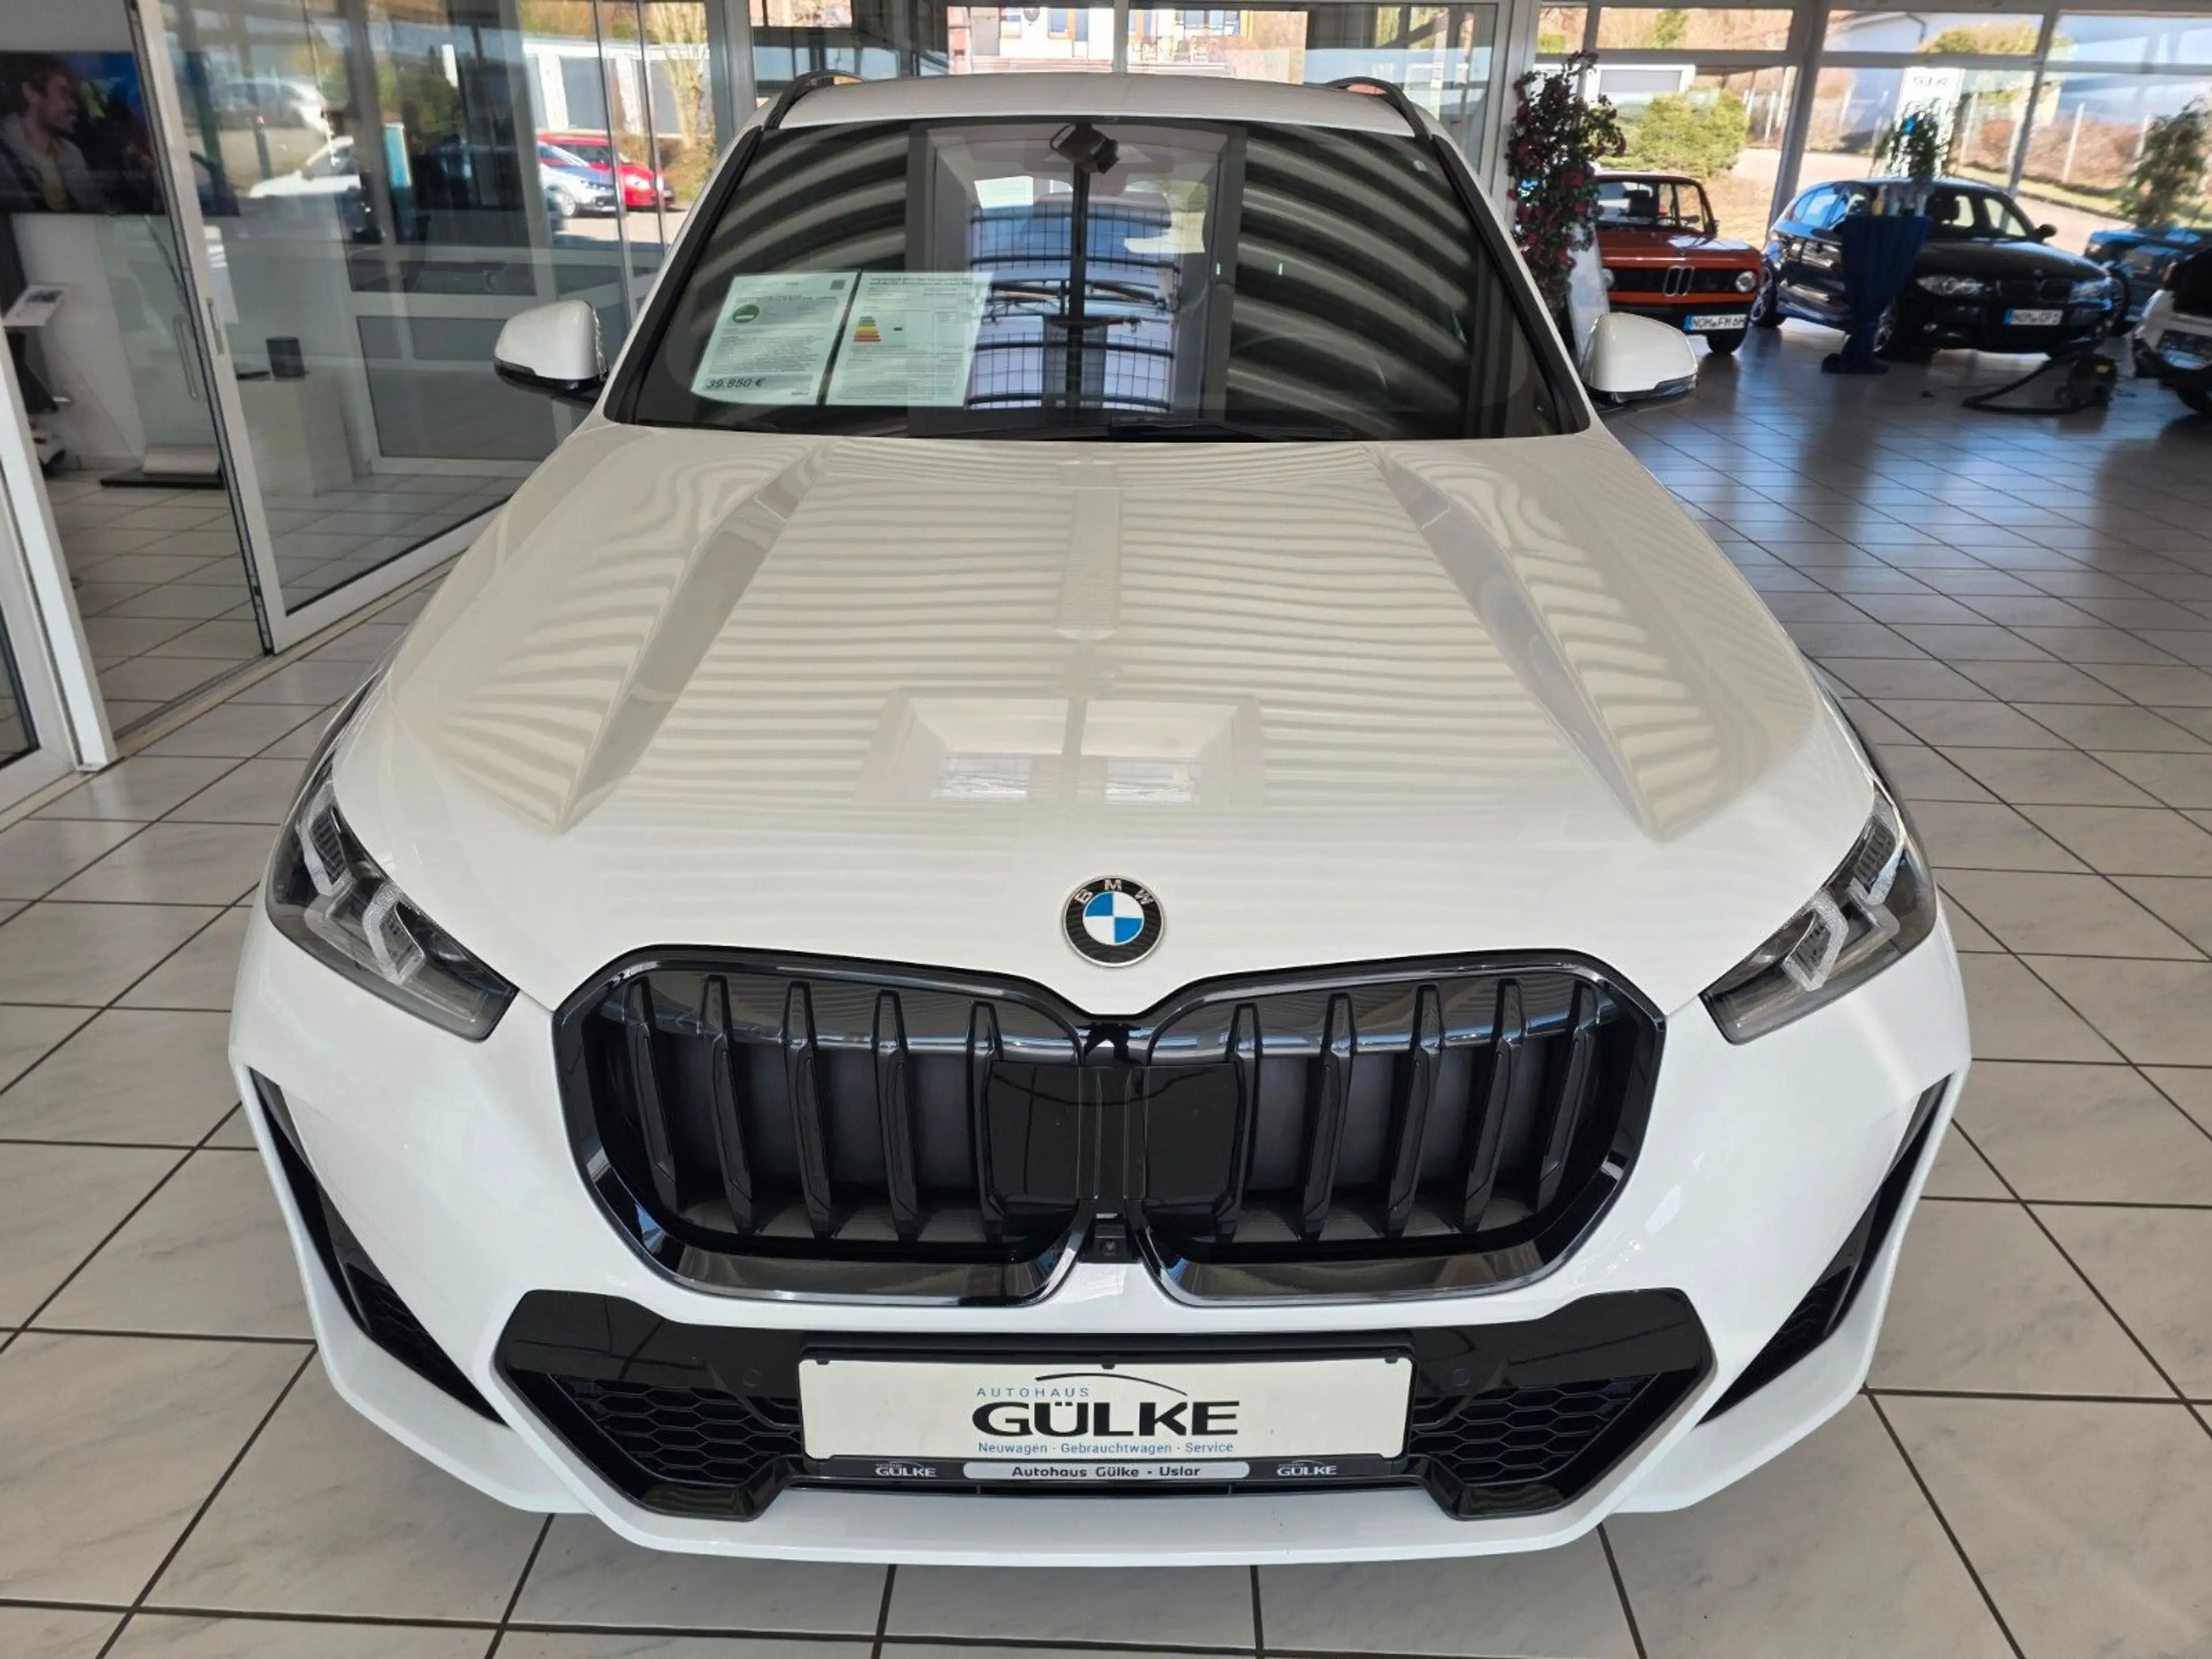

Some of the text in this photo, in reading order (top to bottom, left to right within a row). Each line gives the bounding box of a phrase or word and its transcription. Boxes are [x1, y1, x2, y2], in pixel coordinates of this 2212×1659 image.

[706, 377, 766, 389] 39.850 €
[1074, 879, 1154, 905] BMW
[976, 1388, 1090, 1397] AUTOHAUS
[972, 1400, 1240, 1437] GÜLKE
[978, 1442, 1234, 1455] Neuwagen Gebrauchtwagen Service
[1012, 1465, 1201, 1478] Autohaus Gülke Uslar
